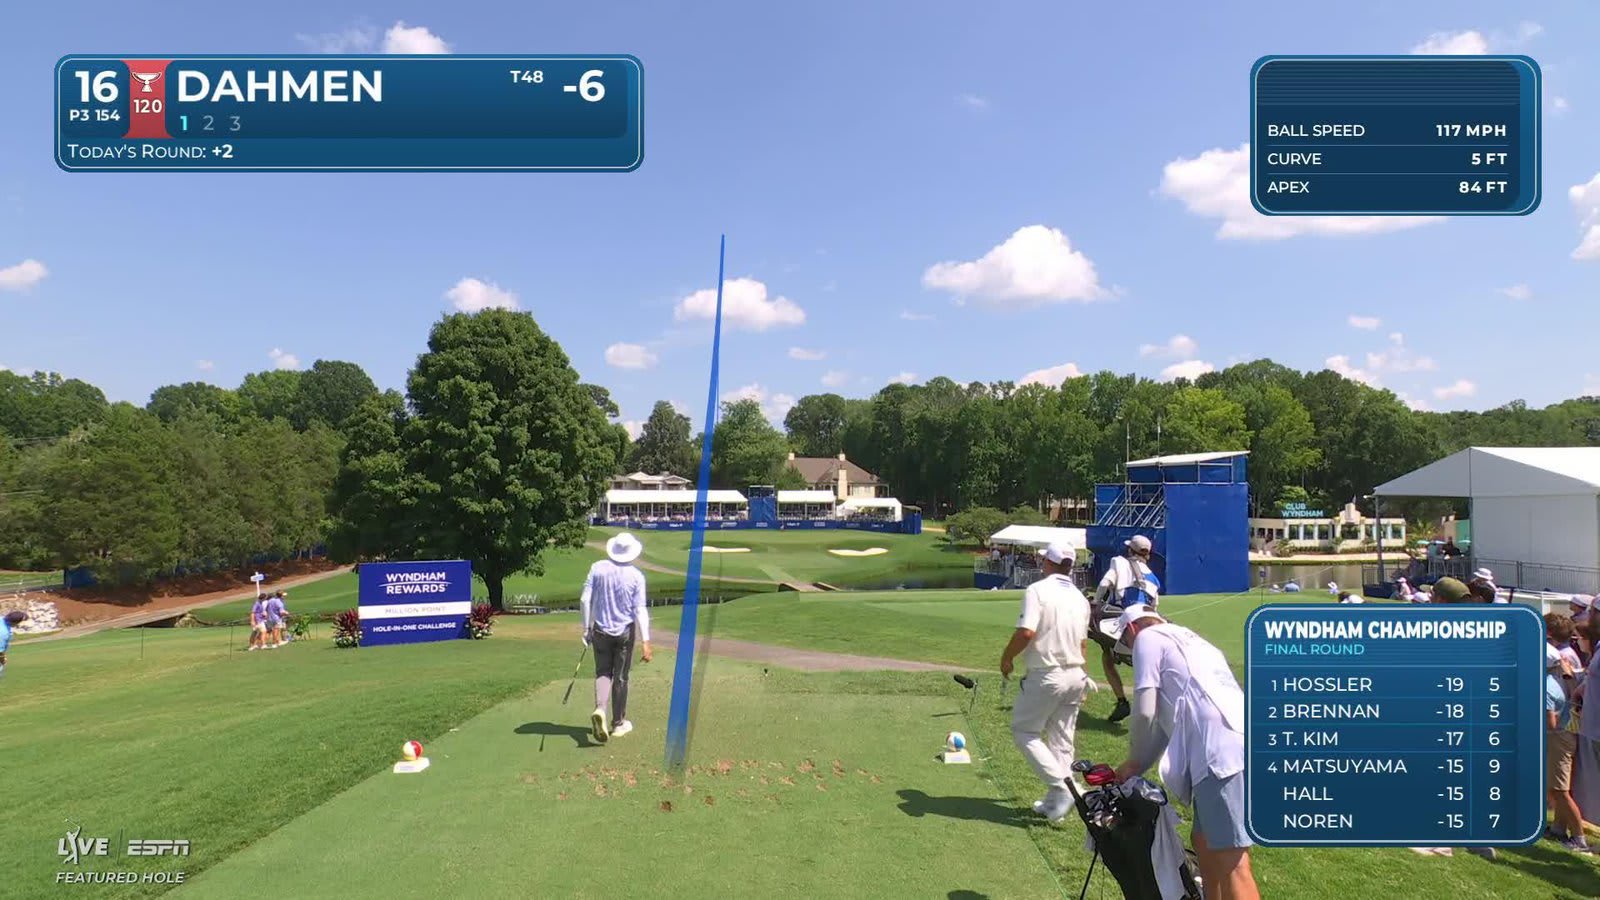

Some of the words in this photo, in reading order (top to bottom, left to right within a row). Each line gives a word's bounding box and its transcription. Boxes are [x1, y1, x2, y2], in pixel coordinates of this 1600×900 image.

[1285, 502, 1306, 510] CLUB
[1281, 510, 1324, 518] WYNDHAM
[386, 571, 446, 583] WYNDHAM
[386, 583, 446, 595] REWARDS
[384, 607, 419, 615] MILLION
[421, 605, 447, 613] POINT
[372, 624, 417, 633] HOLE-IN-ONE
[417, 621, 457, 631] CHALLENGE
